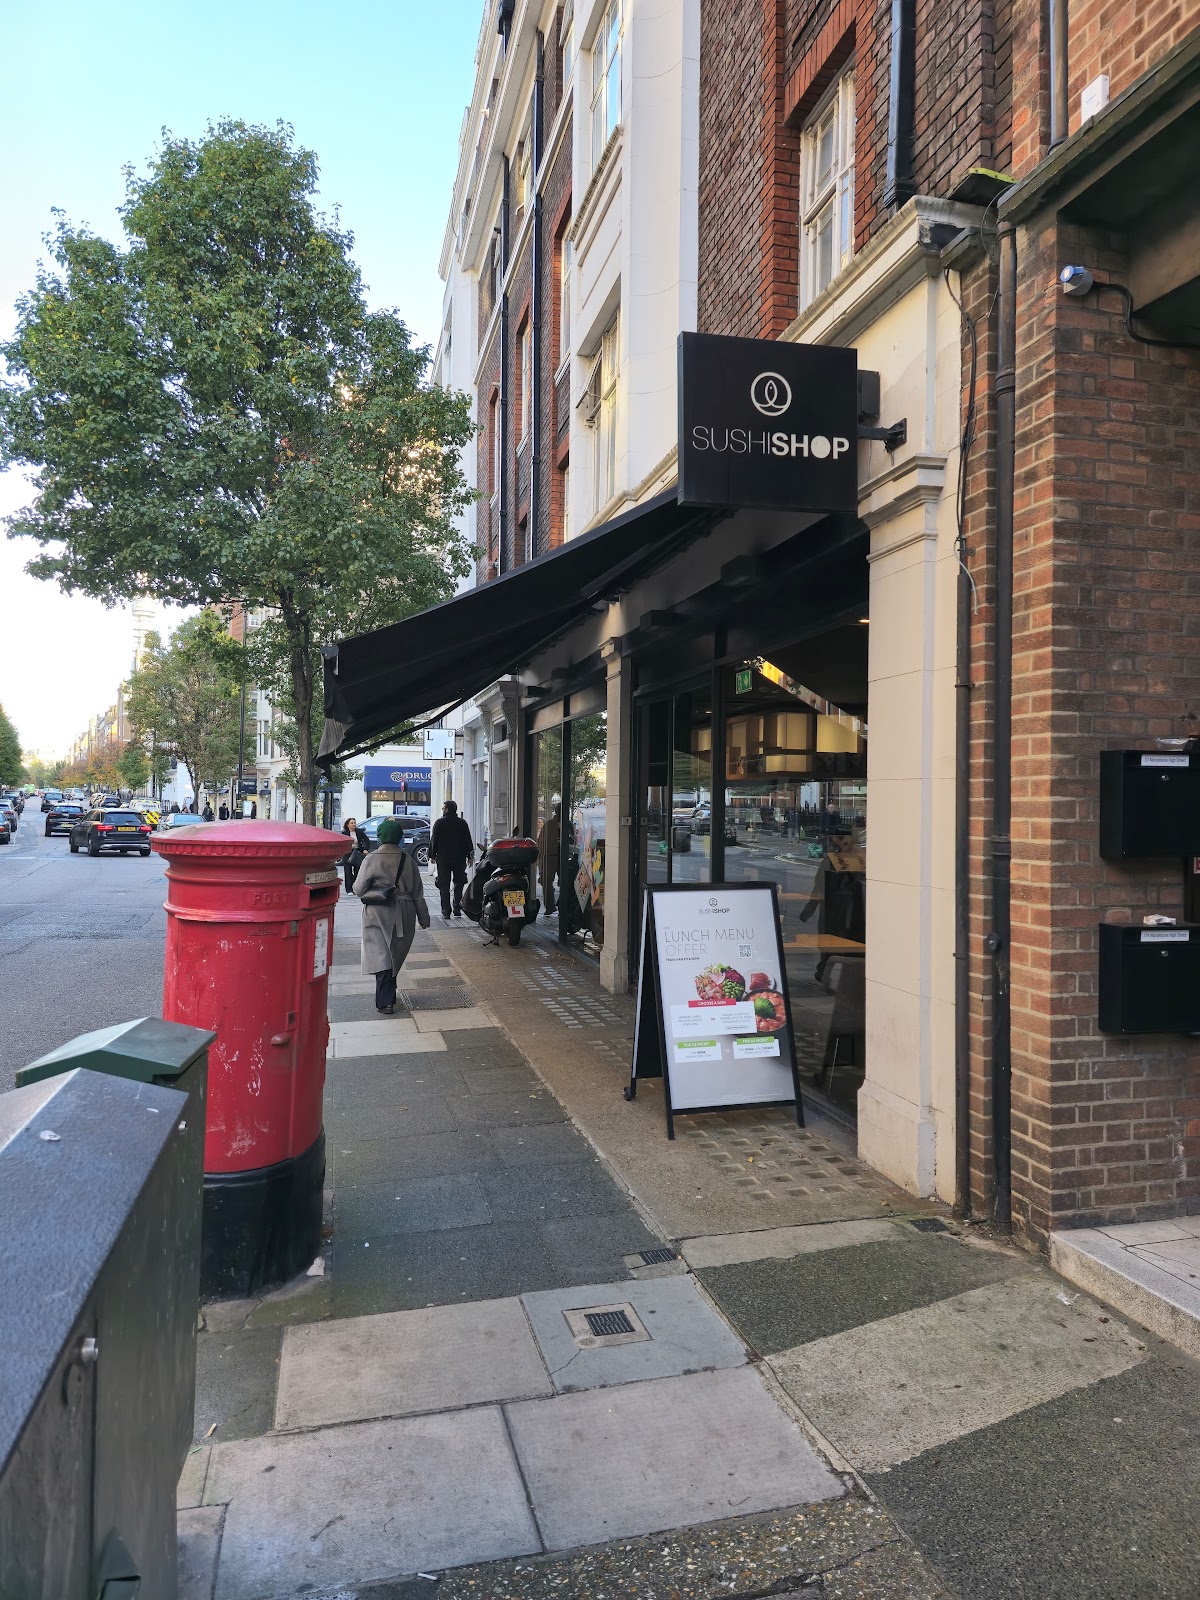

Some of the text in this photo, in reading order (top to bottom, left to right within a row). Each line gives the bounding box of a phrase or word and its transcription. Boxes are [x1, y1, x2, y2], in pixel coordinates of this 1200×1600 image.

[692, 425, 850, 460] SUSHISHOP
[426, 730, 434, 740] L
[444, 748, 454, 758] H
[253, 892, 289, 905] POST
[512, 906, 520, 914] L
[664, 927, 755, 943] LUNCH MENU
[665, 943, 708, 957] OFFER
